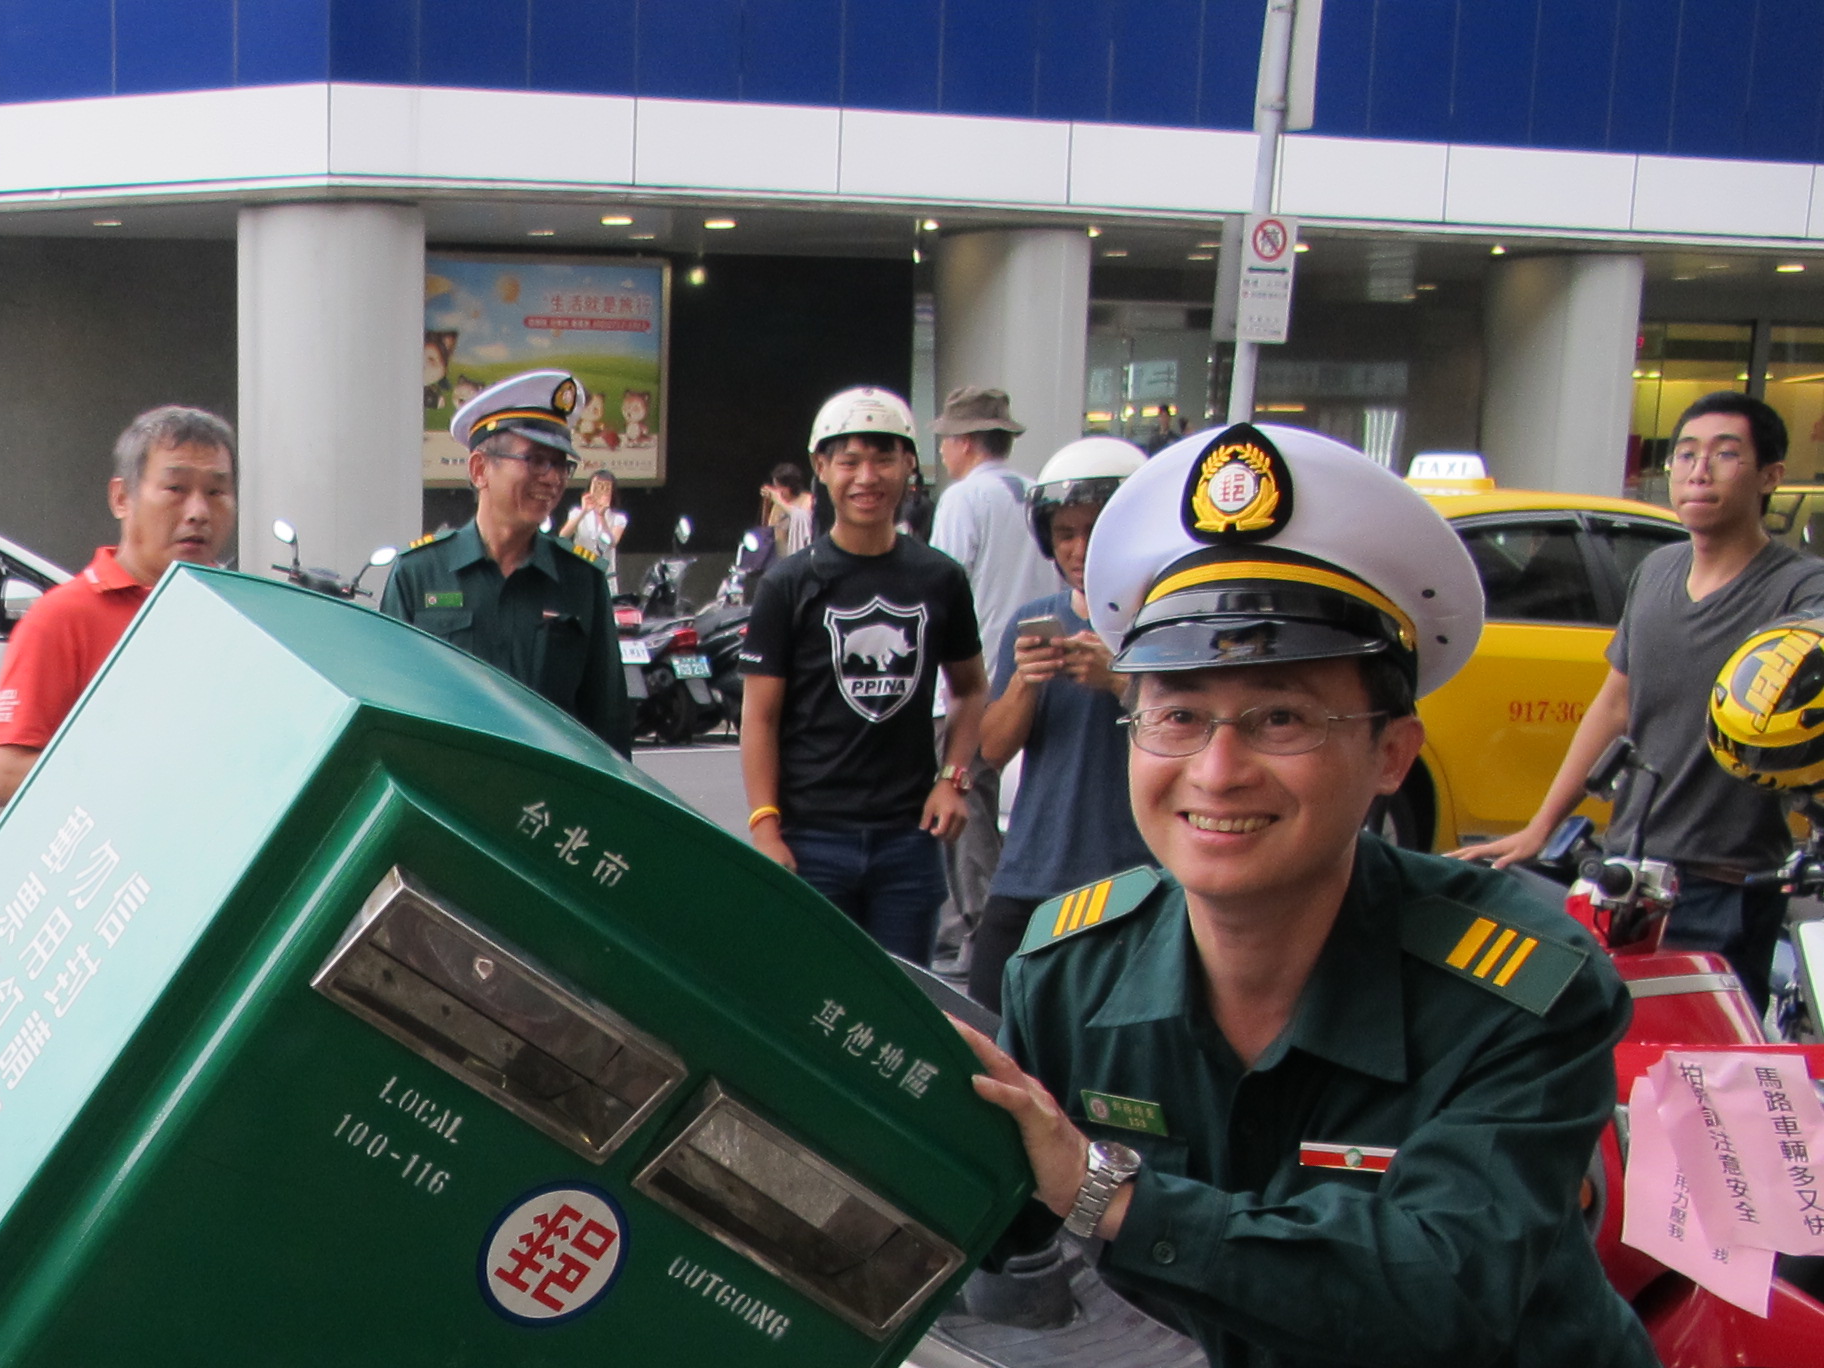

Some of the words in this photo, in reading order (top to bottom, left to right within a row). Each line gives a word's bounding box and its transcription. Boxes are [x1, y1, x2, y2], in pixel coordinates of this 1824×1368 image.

[1417, 461, 1469, 476] TAXI
[851, 679, 907, 695] PPINA
[517, 801, 630, 888] 台北市
[808, 999, 940, 1099] 其他地區
[378, 1075, 464, 1144] LOCAL
[333, 1112, 451, 1195] 100-116
[667, 1255, 792, 1340] OUTGOING
